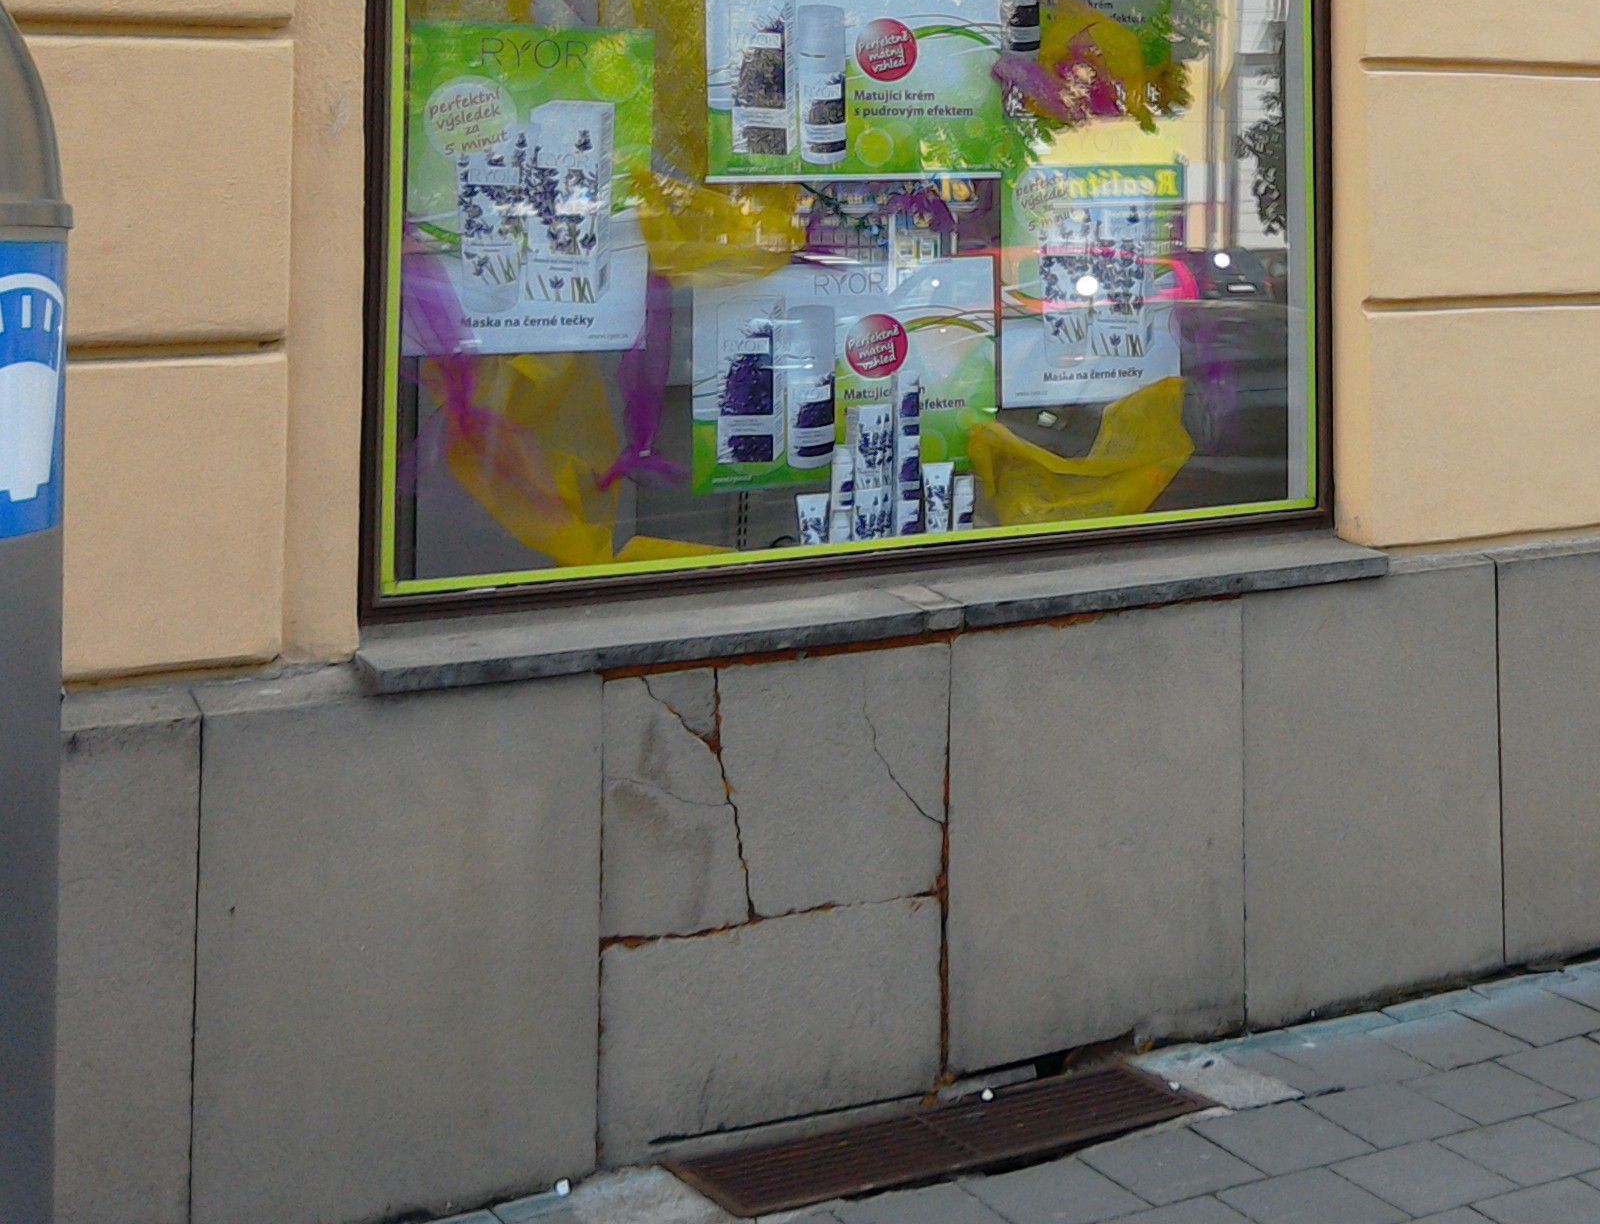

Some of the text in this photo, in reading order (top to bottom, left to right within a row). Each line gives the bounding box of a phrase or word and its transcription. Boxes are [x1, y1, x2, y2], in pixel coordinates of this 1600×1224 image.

[481, 37, 589, 69] RYOR
[429, 87, 501, 120] perfektní
[854, 90, 935, 104] Matující krém
[436, 105, 501, 132] výsledek
[863, 104, 924, 118] pudrovým
[926, 106, 974, 117] efektem
[465, 126, 480, 135] za
[445, 130, 510, 156] 5 minut
[813, 273, 885, 296] RYOR
[505, 319, 520, 328] na
[523, 315, 558, 328] černé
[560, 316, 595, 332] tečky
[1076, 372, 1088, 380] na
